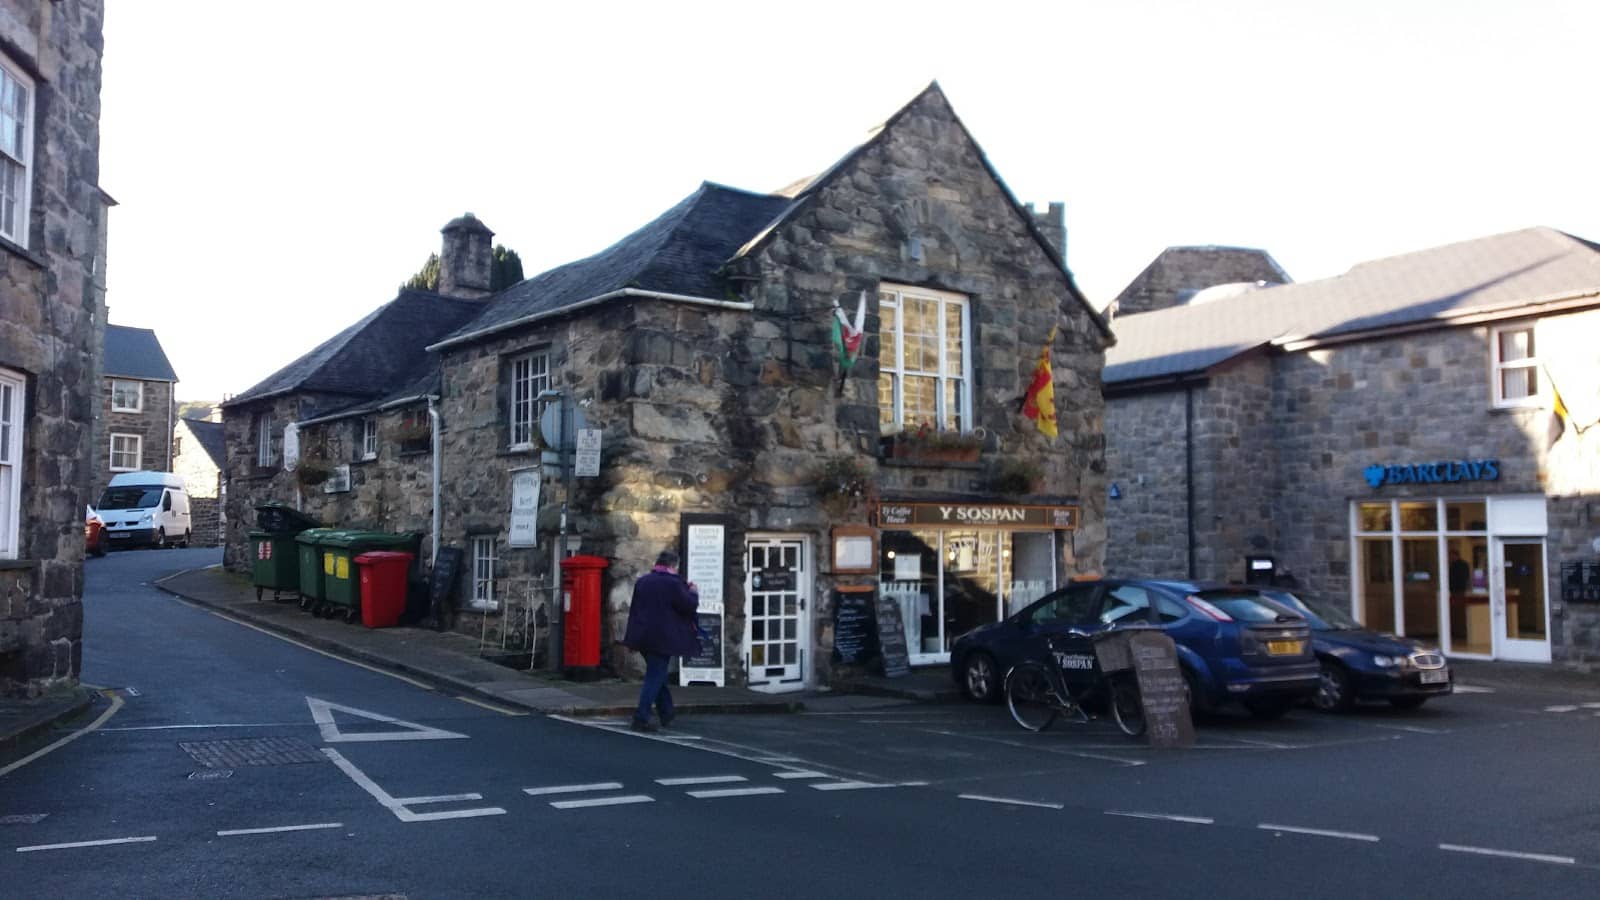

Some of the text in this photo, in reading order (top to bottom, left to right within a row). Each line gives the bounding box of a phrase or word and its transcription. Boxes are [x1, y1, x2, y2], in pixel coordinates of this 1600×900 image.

[1386, 459, 1498, 484] BARCLAYS
[939, 506, 1025, 521] Y SOSPAN
[1062, 659, 1093, 669] SOSPAN
